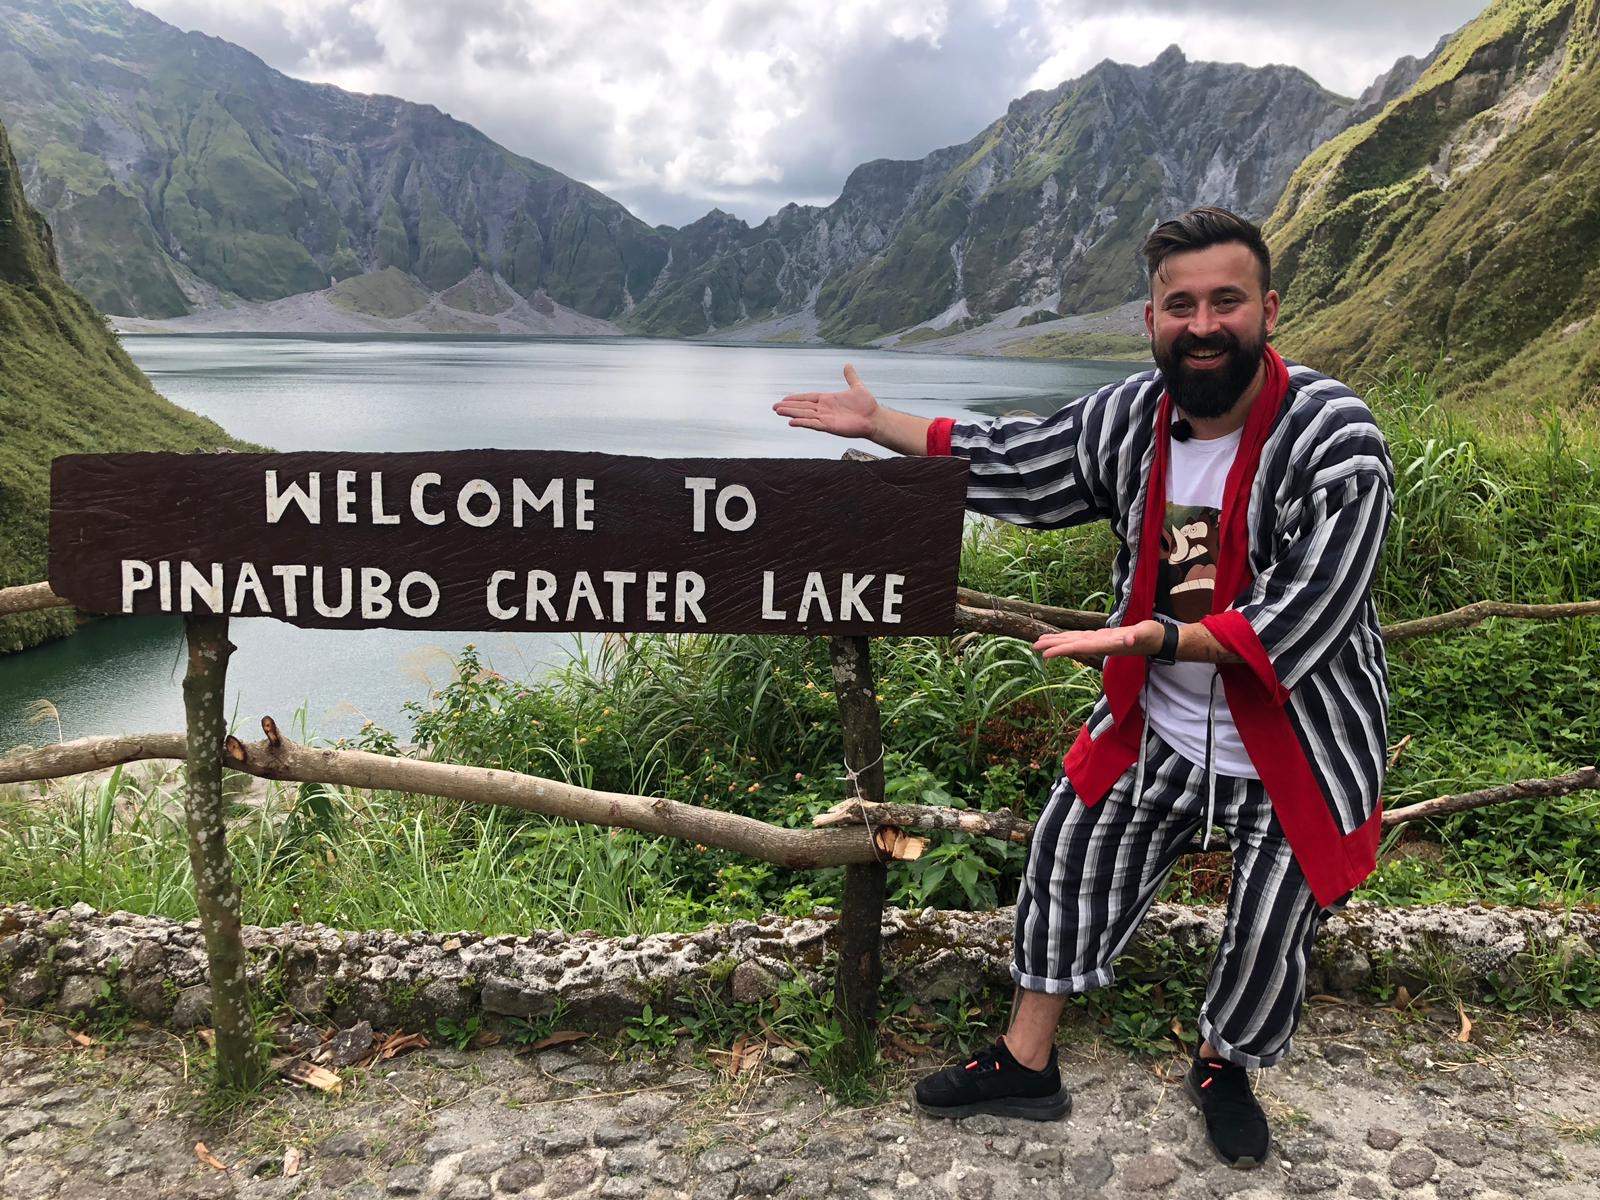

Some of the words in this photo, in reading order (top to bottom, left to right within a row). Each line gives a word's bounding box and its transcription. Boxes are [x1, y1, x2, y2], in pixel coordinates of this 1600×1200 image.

[265, 470, 595, 532] WELCOME
[685, 476, 757, 533] TO
[121, 559, 440, 621] PINATUBO
[486, 569, 707, 625] CRATER
[761, 570, 906, 625] LAKE
